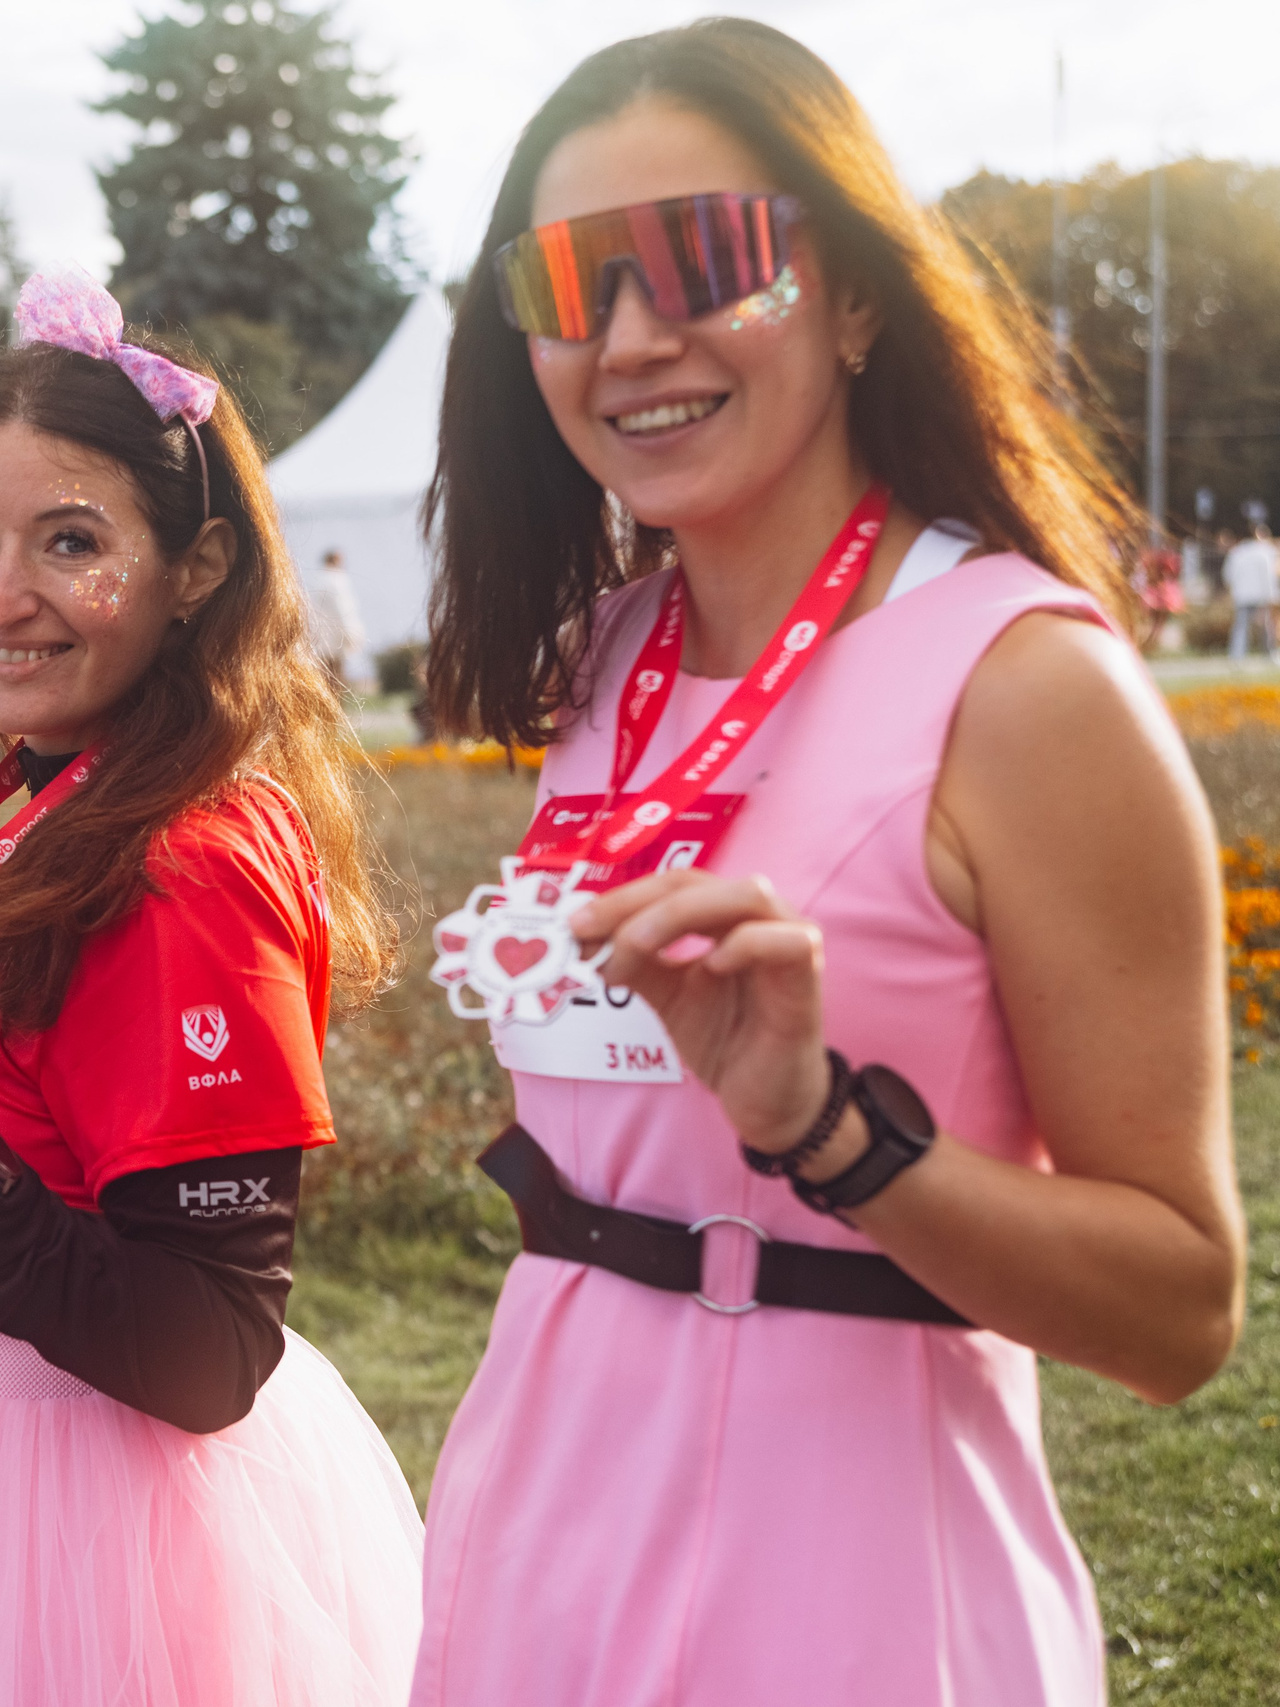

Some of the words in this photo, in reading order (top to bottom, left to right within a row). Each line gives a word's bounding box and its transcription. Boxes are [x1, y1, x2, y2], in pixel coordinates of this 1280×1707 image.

[605, 1042, 619, 1070] 3
[188, 1068, 243, 1091] ВФЛА
[178, 1177, 271, 1208] HRX
